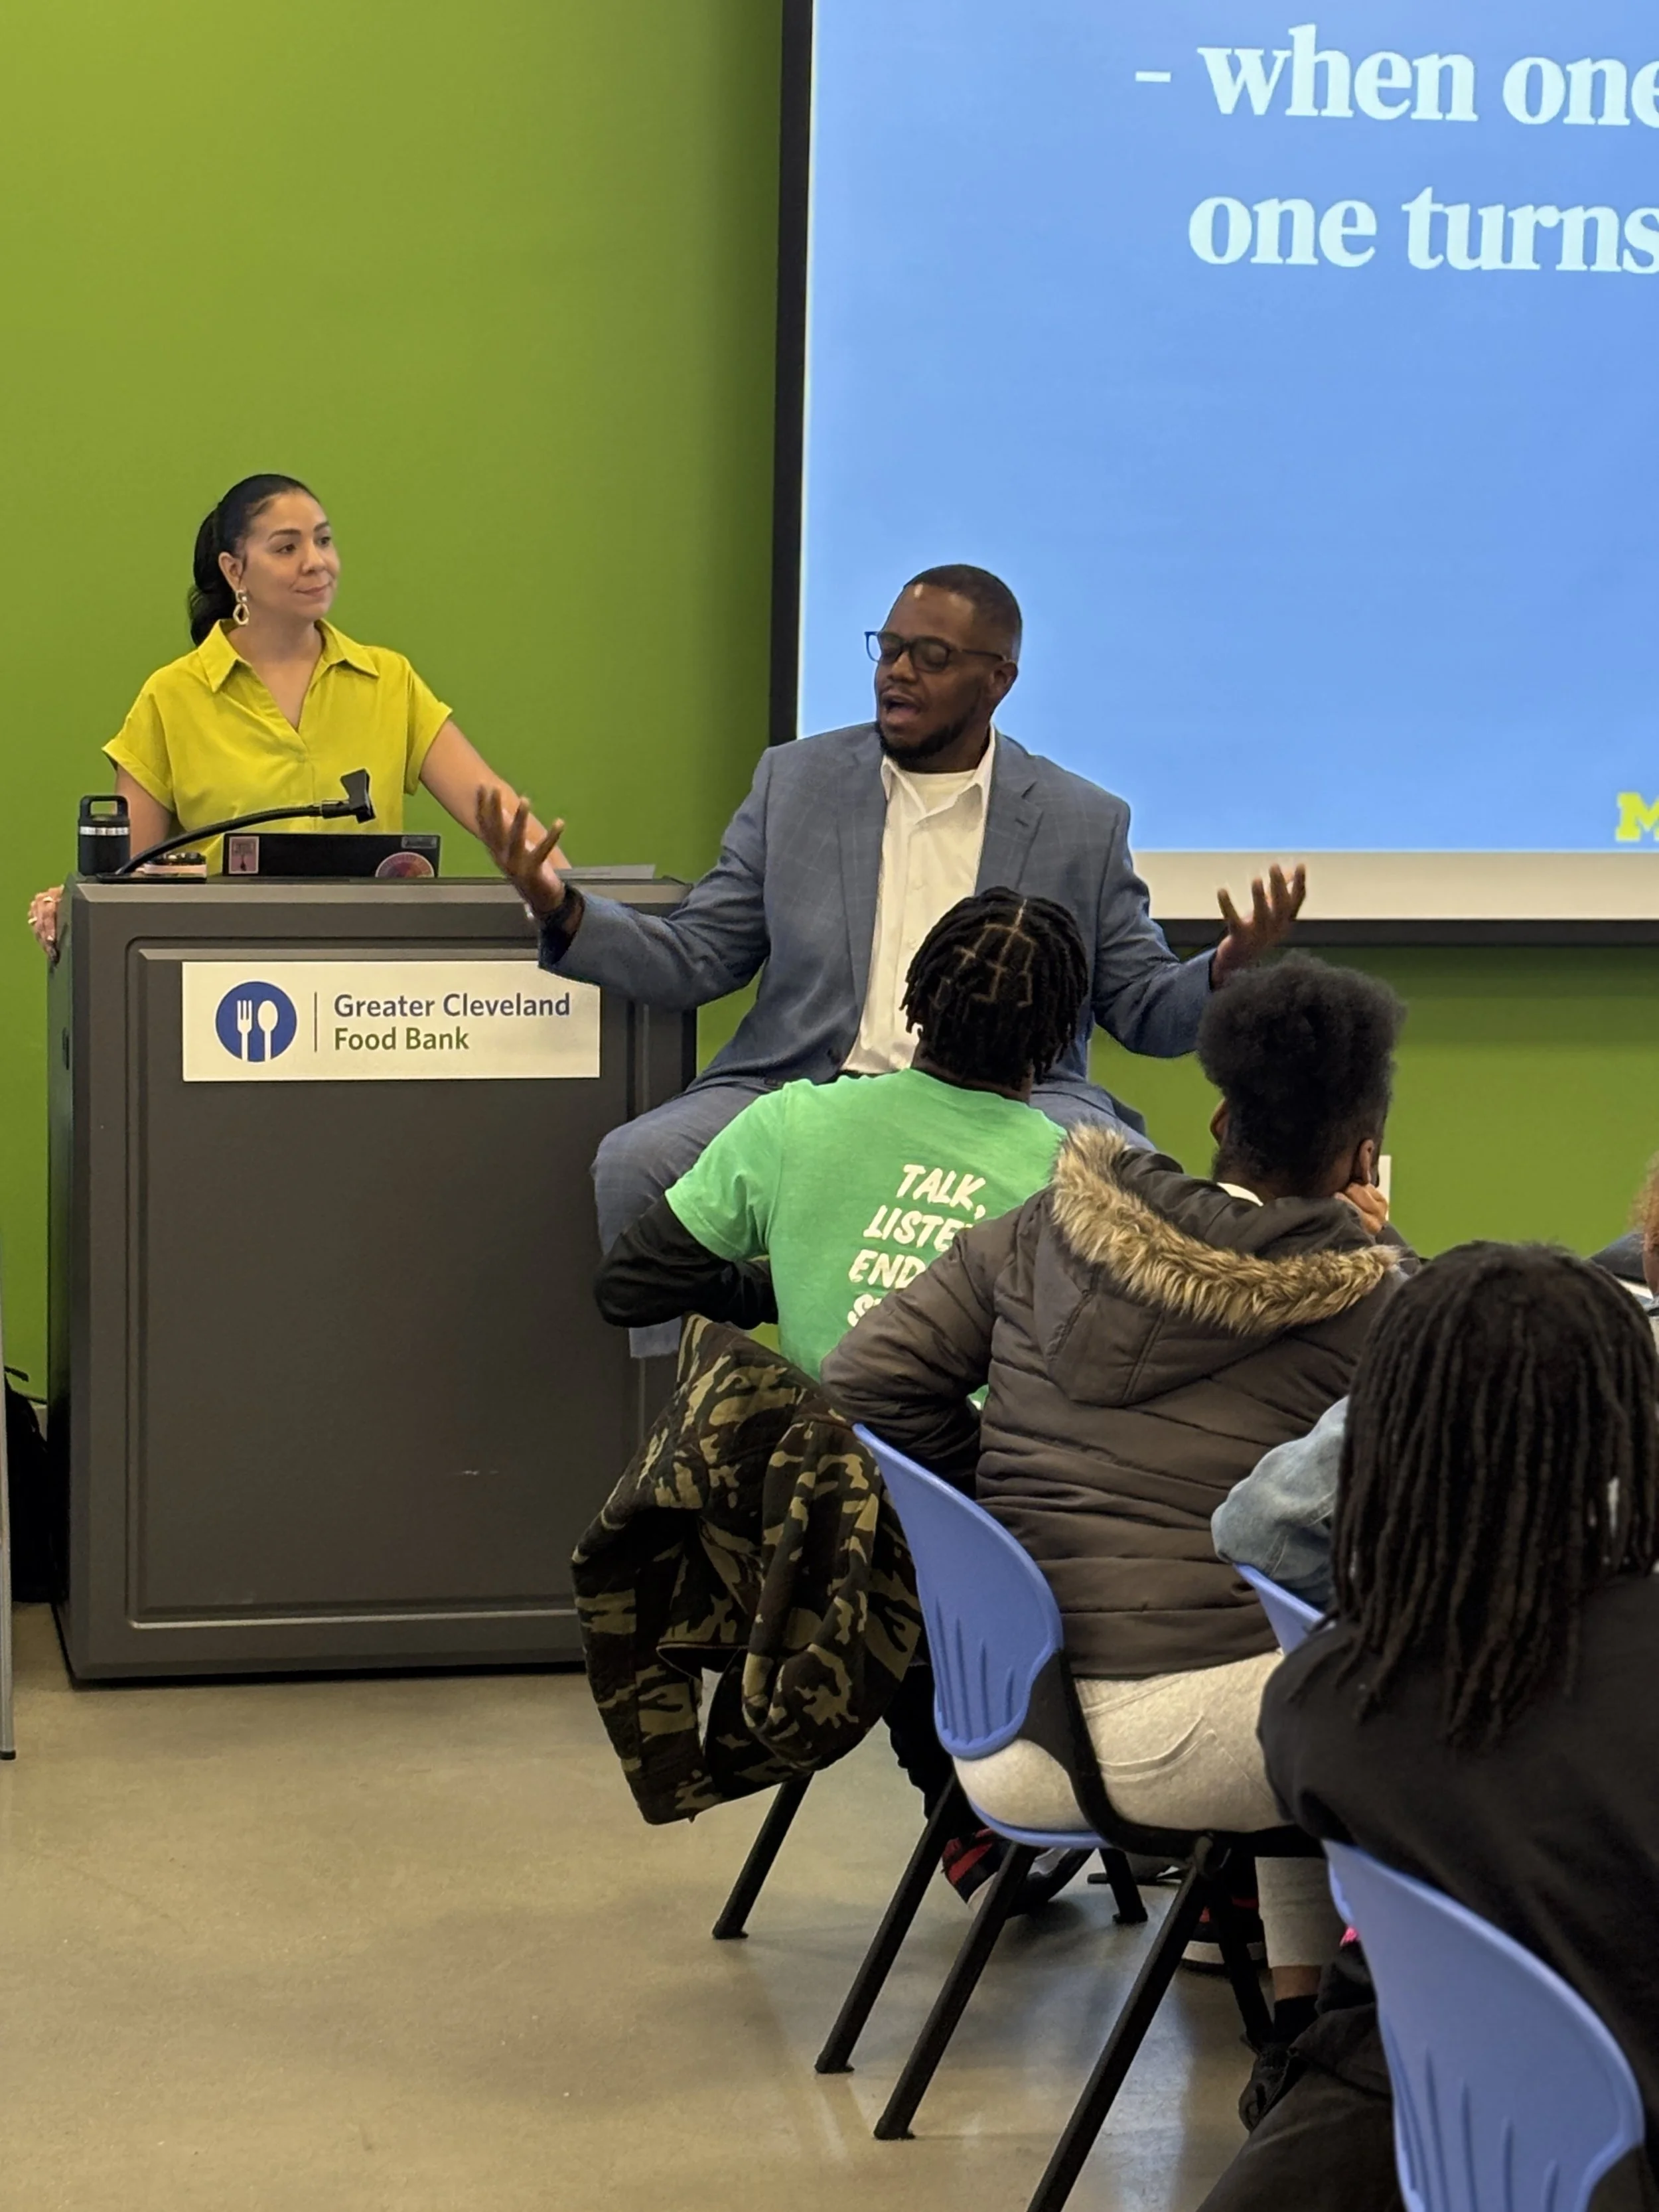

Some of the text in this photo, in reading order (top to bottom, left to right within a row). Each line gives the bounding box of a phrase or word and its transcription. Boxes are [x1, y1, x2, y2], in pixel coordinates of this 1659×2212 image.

[1196, 23, 1479, 121] when
[1189, 186, 1659, 274] one turns
[334, 992, 570, 1017] Greater Cleveland
[334, 1025, 469, 1051] Food Bank
[896, 1164, 986, 1220] TALK,
[863, 1205, 973, 1252] LISTE
[848, 1249, 926, 1289] END
